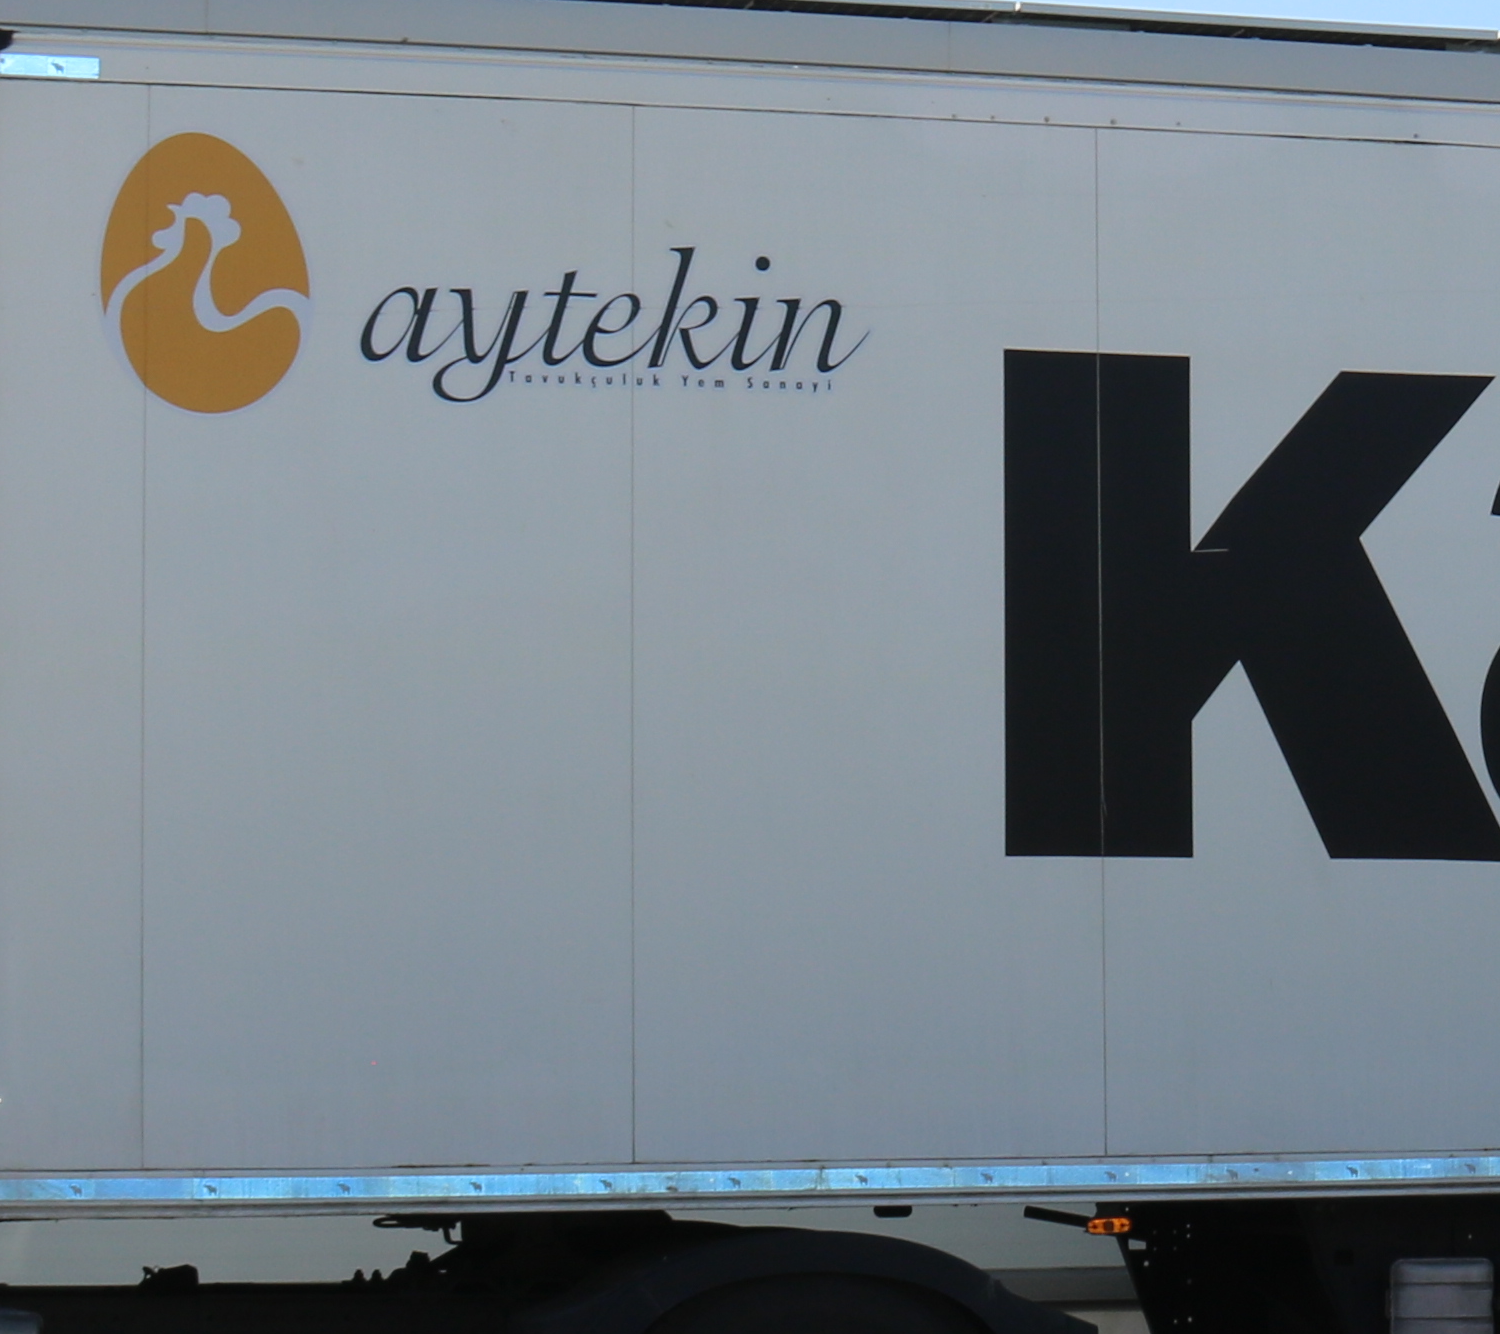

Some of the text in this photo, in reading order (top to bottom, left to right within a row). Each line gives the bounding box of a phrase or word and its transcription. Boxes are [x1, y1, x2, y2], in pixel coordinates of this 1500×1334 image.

[360, 246, 867, 403] aytekin
[508, 369, 832, 392] Tavukçuluk Yem Sanayi
